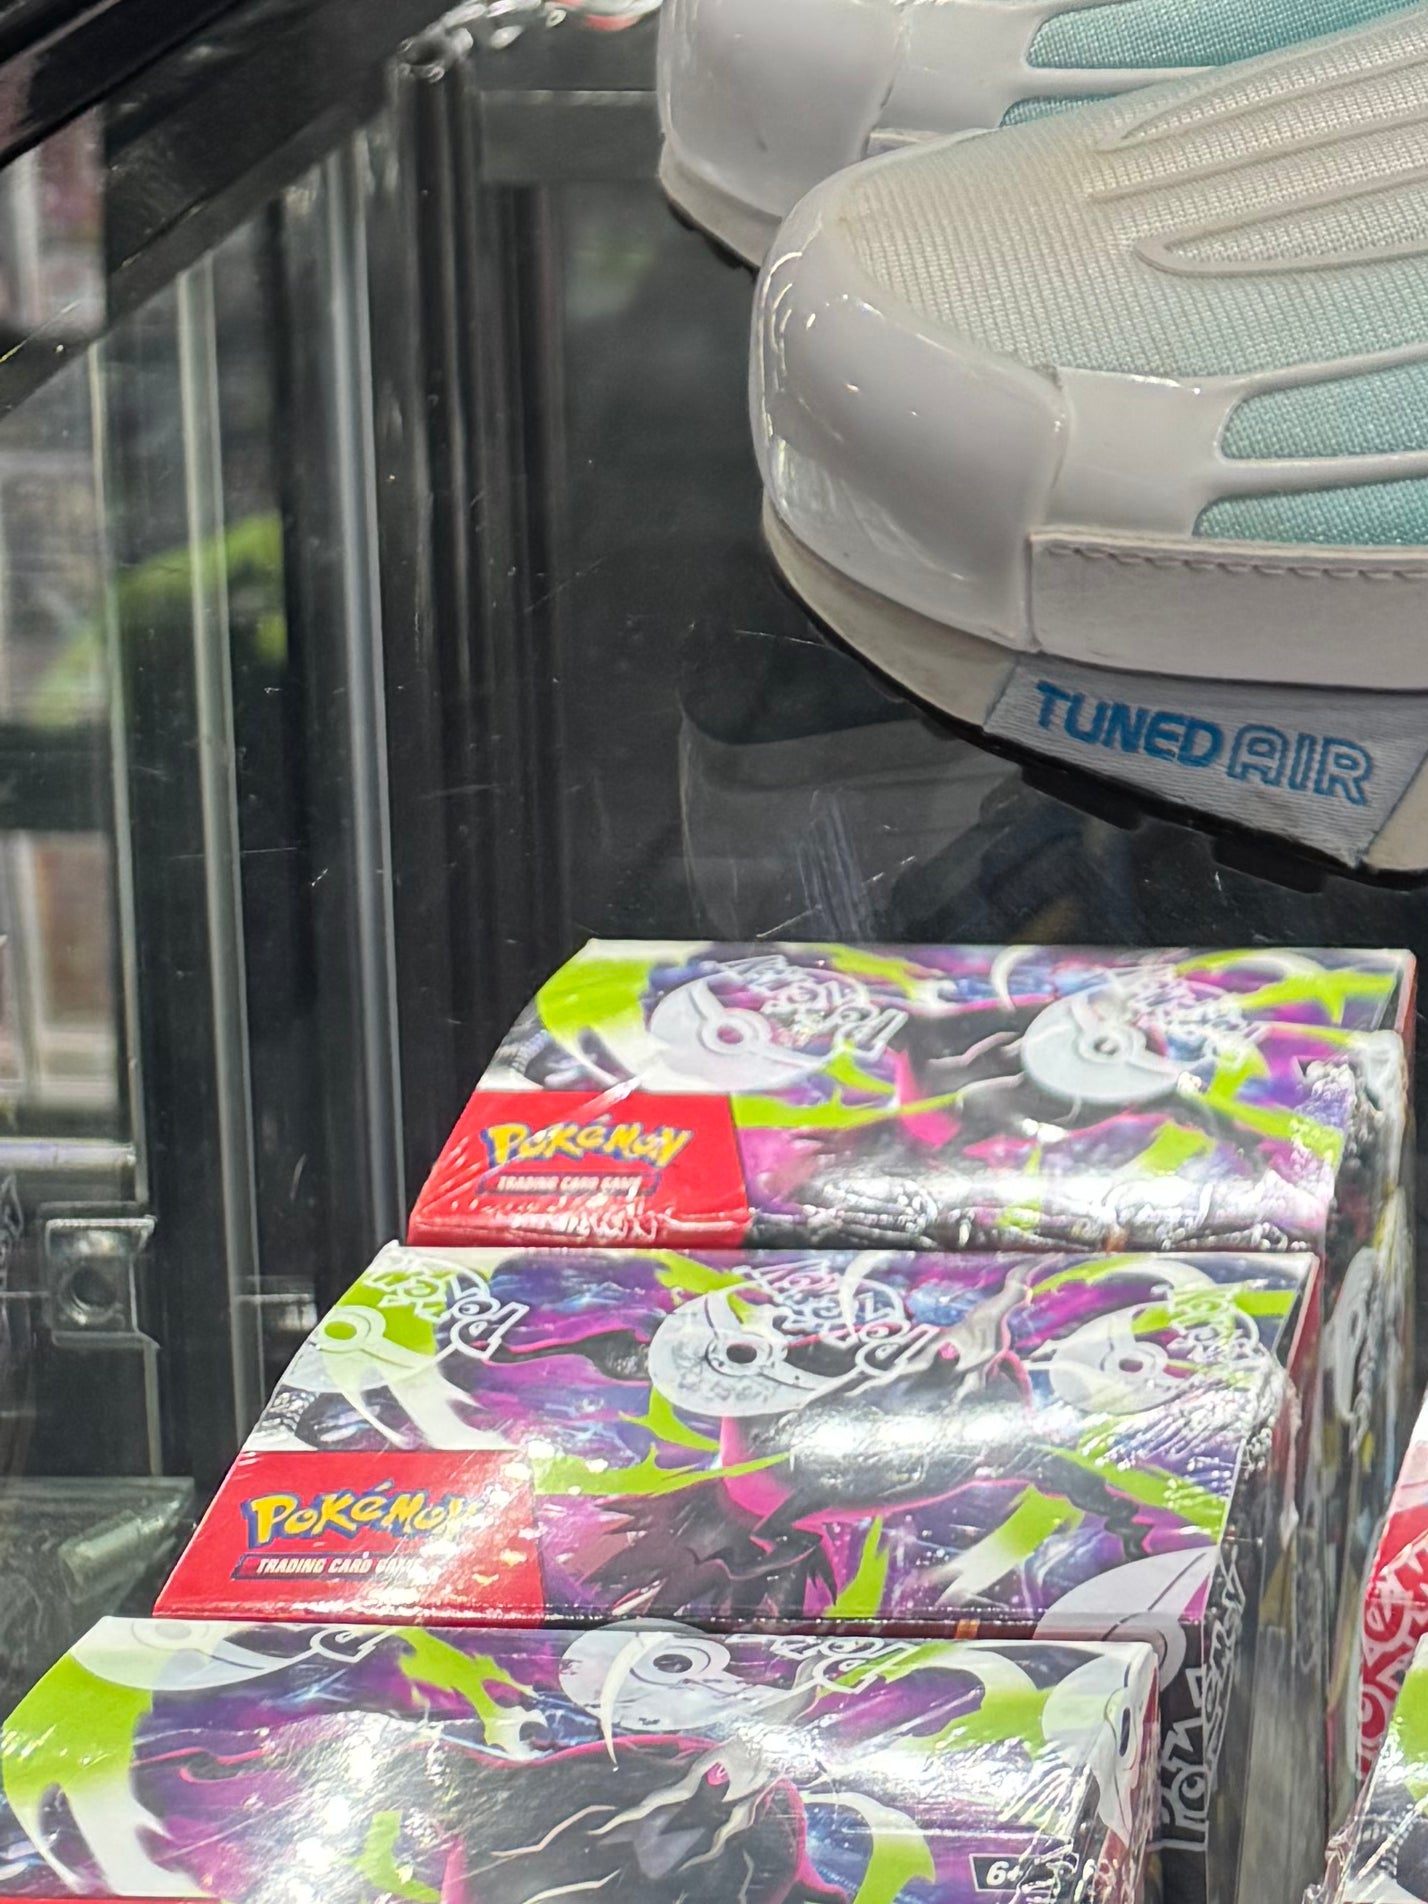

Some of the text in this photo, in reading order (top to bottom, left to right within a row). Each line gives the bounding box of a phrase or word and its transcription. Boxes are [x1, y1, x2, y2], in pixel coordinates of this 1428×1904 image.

[1035, 679, 1376, 806] TUNED AIR
[496, 1176, 559, 1191] TRADING
[560, 1176, 598, 1191] CARD
[256, 1558, 326, 1574] TRADING
[328, 1558, 373, 1574] CARD
